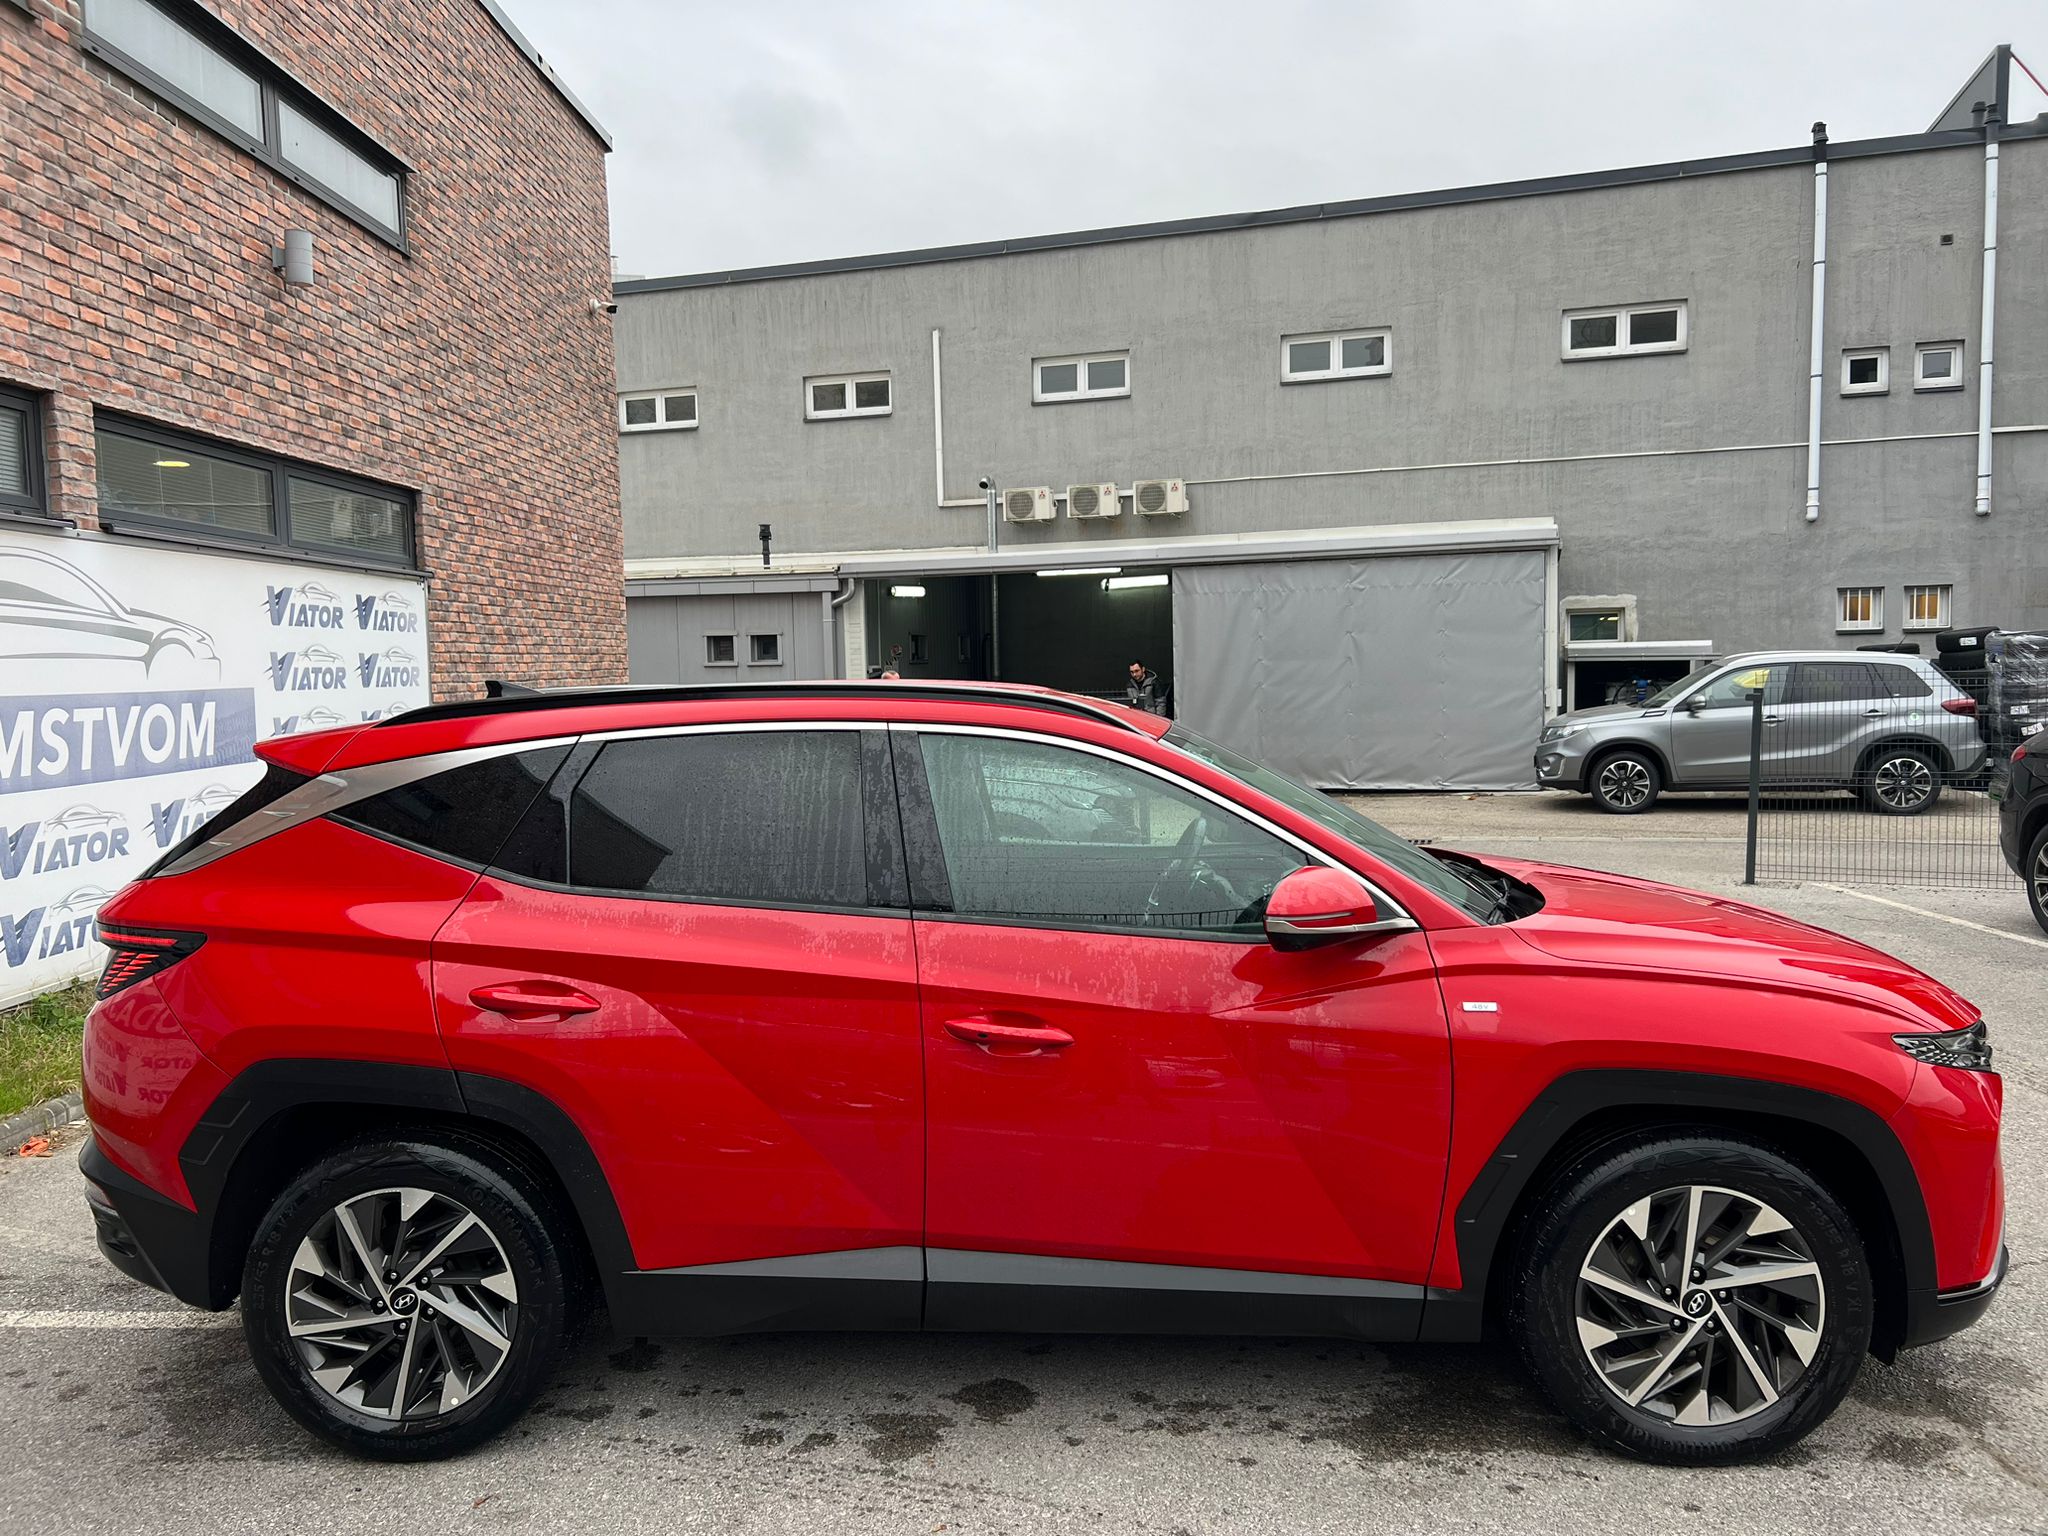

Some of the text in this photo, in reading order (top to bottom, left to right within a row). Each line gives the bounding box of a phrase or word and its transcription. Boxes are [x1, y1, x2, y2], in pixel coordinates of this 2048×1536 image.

[263, 586, 344, 629] VIATOR
[354, 594, 418, 632] VIATOR
[267, 651, 347, 691] VIATOR
[357, 652, 421, 688] VIATOR
[0, 821, 130, 880] VIATOR
